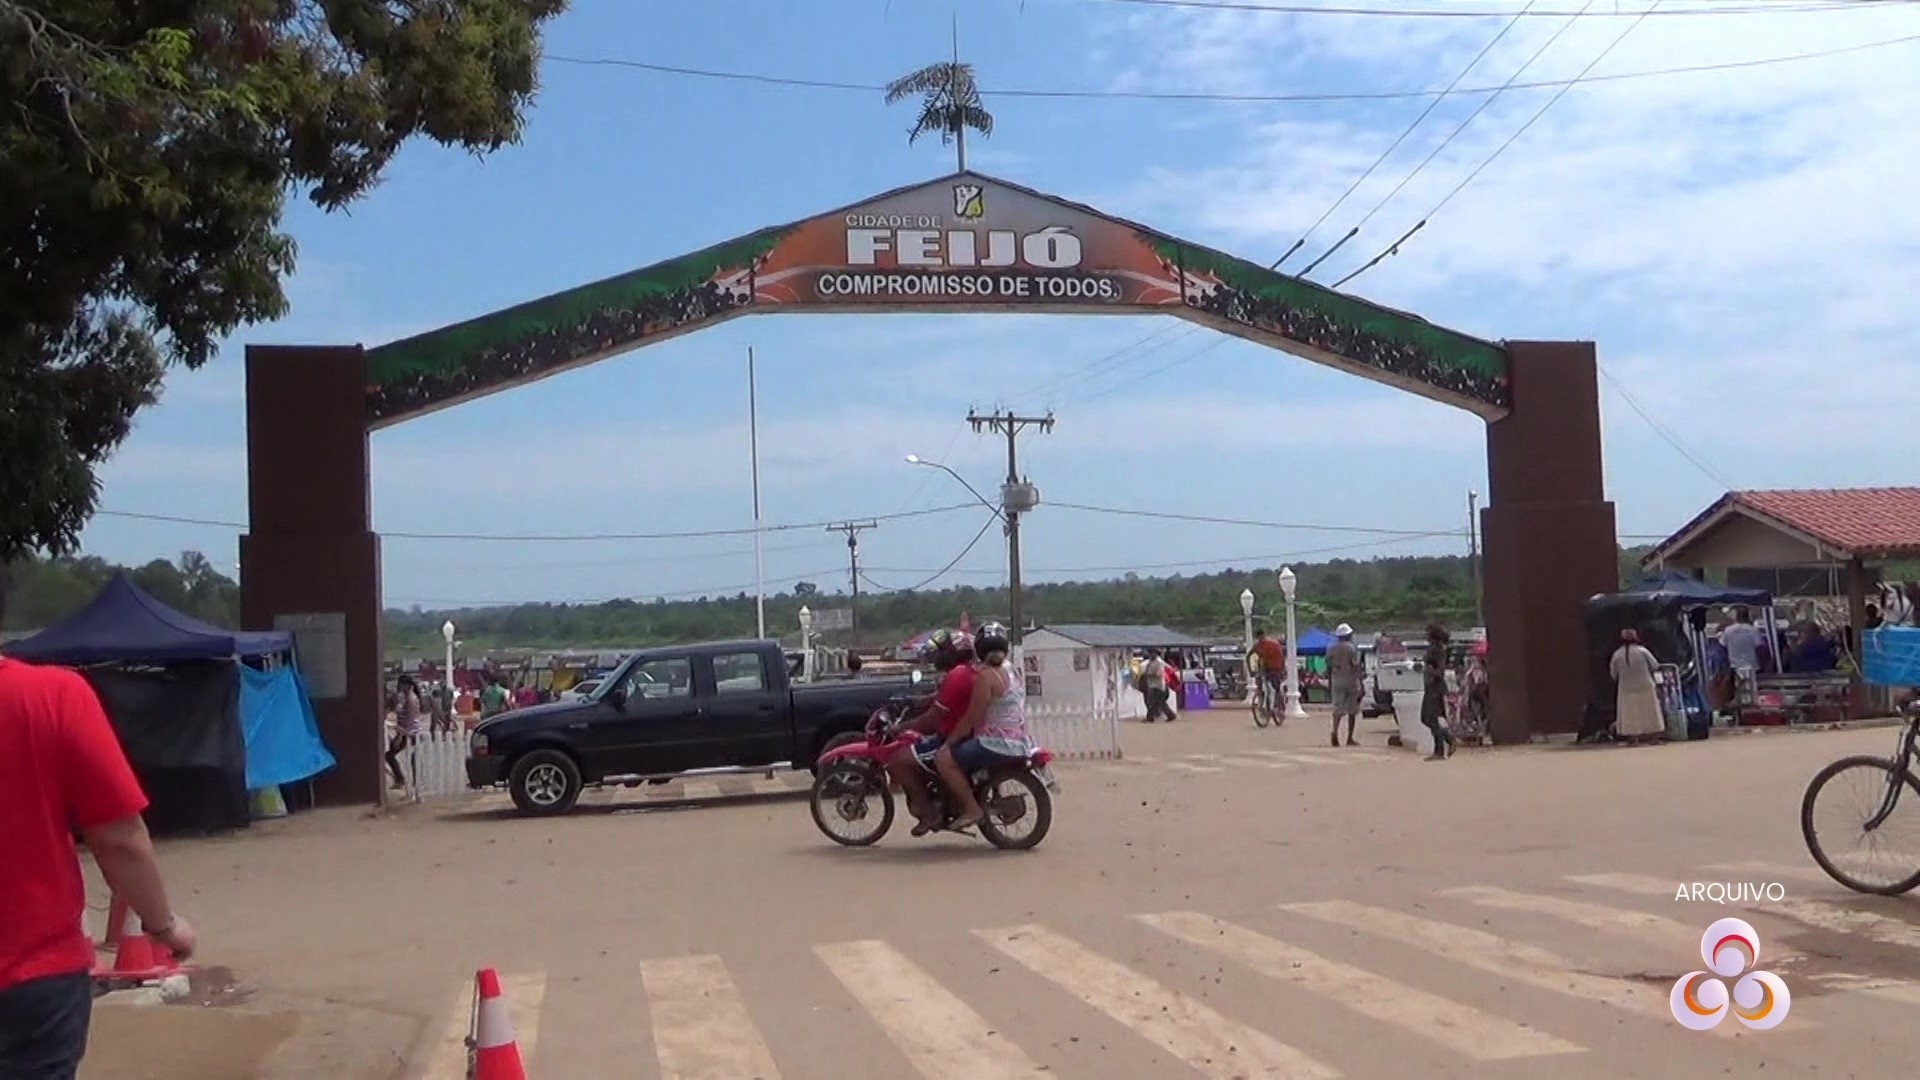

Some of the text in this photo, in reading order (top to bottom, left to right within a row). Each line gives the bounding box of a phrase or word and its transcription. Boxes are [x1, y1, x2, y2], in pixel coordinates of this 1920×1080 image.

[845, 214, 912, 228] CIDADE
[846, 226, 1082, 268] FEIJÓ
[819, 273, 994, 296] COMPROMISSO
[1000, 275, 1030, 297] DE
